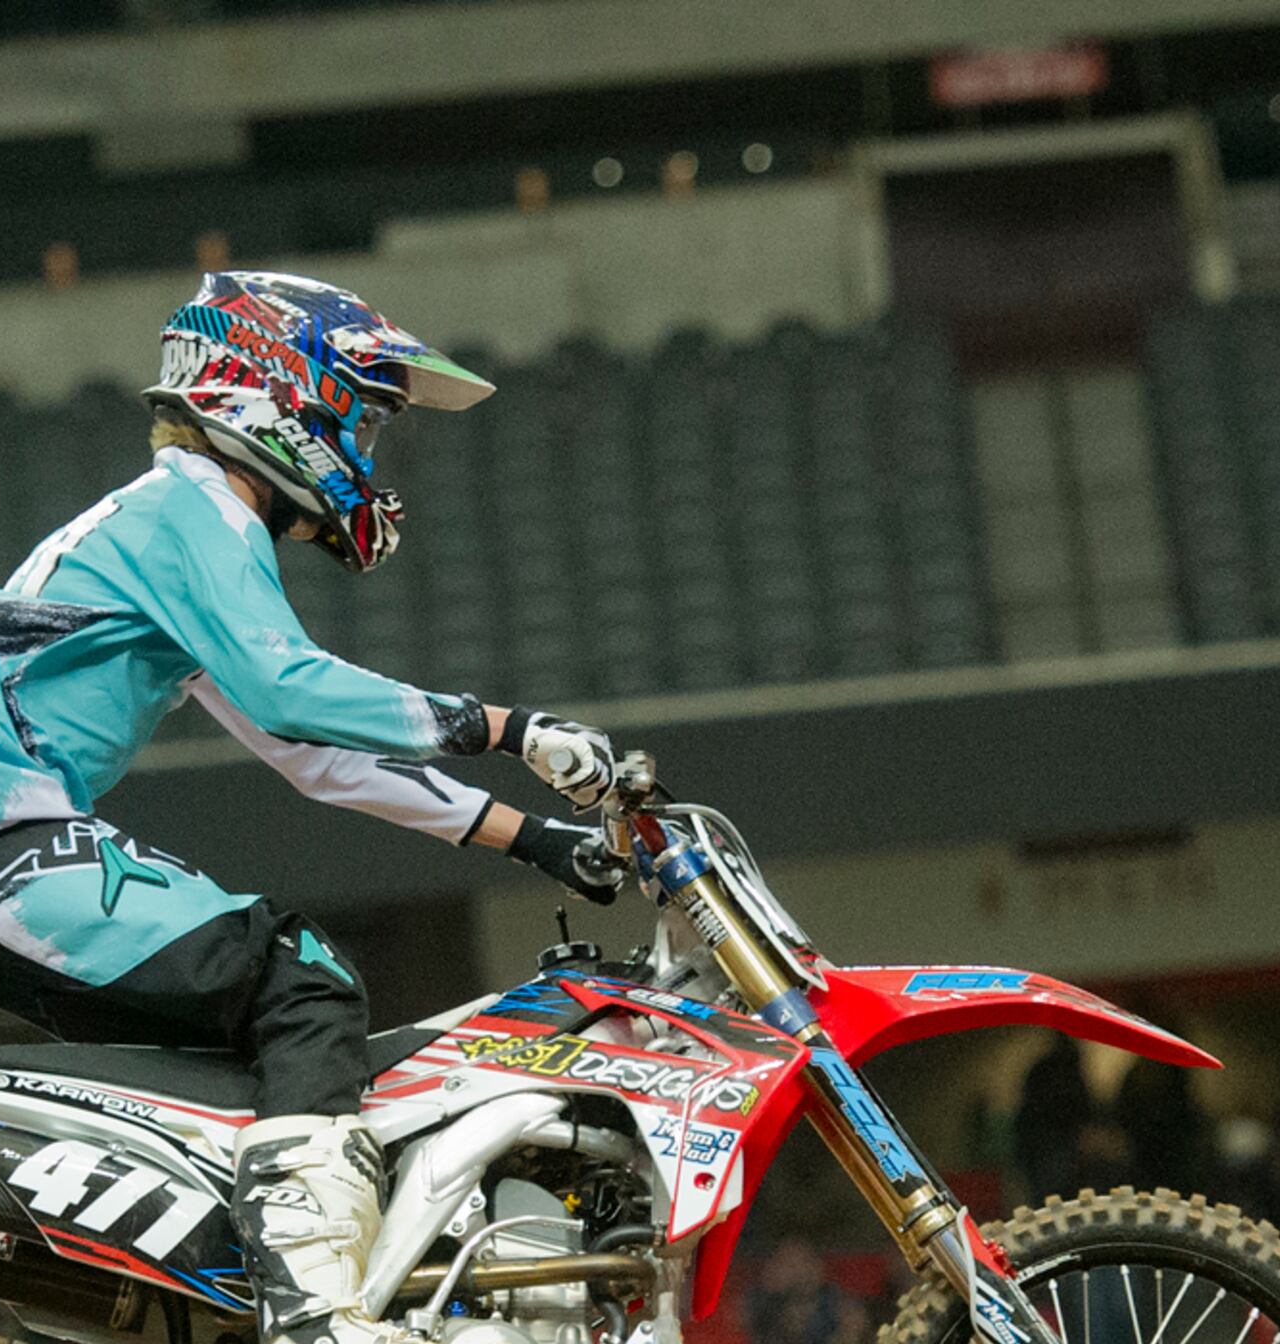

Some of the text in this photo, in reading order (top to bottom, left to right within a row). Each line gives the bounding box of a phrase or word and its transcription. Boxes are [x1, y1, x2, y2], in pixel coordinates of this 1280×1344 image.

[226, 322, 310, 388] UTOPIA
[13, 1076, 158, 1119] KARNOW
[568, 1050, 757, 1112] DESIGNS
[656, 1117, 715, 1148] Mom
[667, 1142, 716, 1164] Dad
[242, 1185, 323, 1216] FOX
